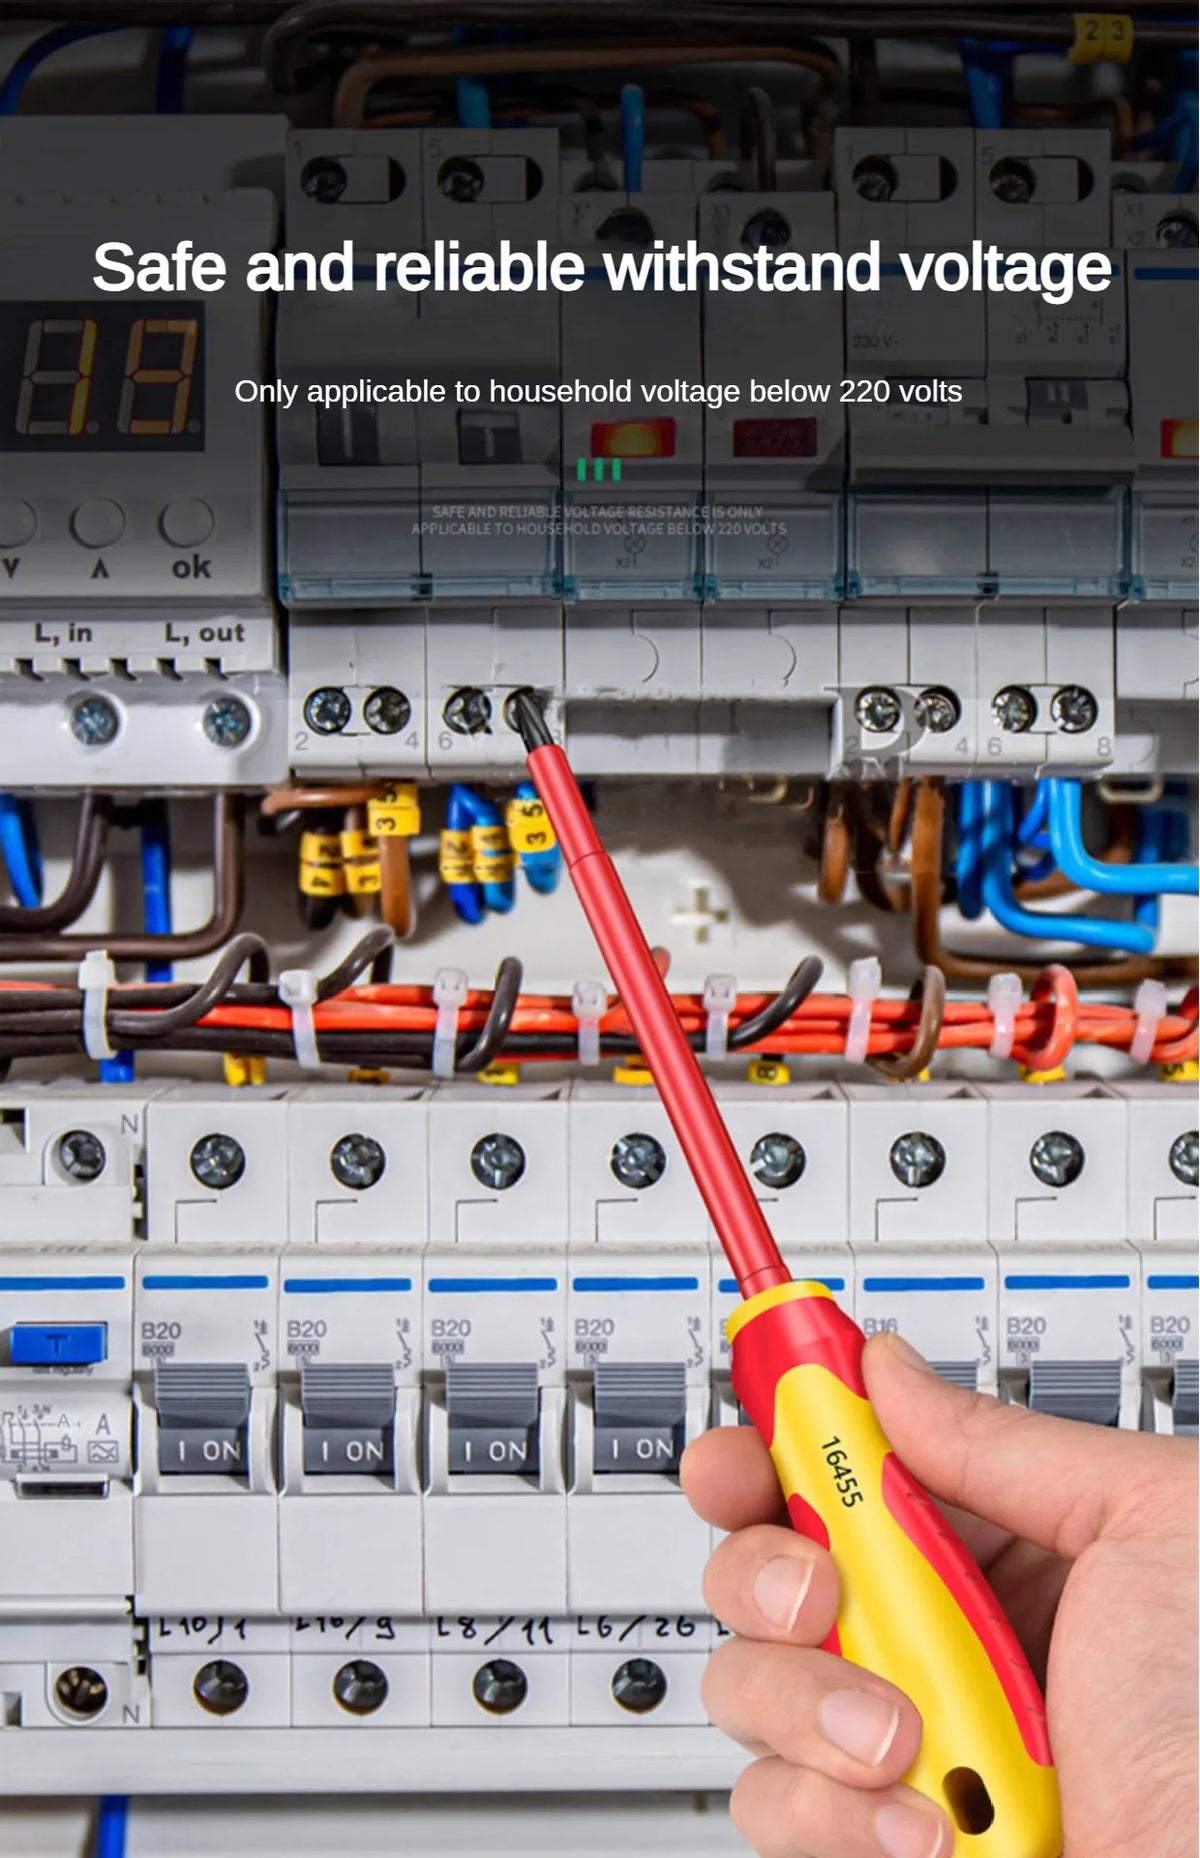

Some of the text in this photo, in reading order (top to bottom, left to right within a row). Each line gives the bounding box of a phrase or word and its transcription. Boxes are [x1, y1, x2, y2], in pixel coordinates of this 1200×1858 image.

[1086, 20, 1125, 41] 2 3
[173, 554, 211, 579] ok
[35, 622, 92, 647] L, in
[165, 622, 244, 647] L, out
[294, 731, 310, 751] 2
[404, 732, 419, 750] 4
[438, 732, 453, 751] 6
[954, 736, 969, 756] 4
[986, 736, 1002, 756] 6
[1097, 736, 1112, 757] 8
[525, 831, 547, 845] 3
[121, 1114, 138, 1133] N
[142, 1321, 182, 1340] B20
[287, 1320, 327, 1338] B20
[431, 1319, 472, 1337] B20
[575, 1318, 615, 1336] B20
[864, 1318, 898, 1335] B16
[1007, 1317, 1046, 1335] B20
[1150, 1316, 1190, 1334] B20
[44, 1333, 70, 1356] T
[96, 1412, 111, 1435] A
[203, 1440, 240, 1461] ON
[346, 1440, 384, 1461] ON
[489, 1440, 527, 1461] ON
[636, 1438, 674, 1459] ON
[822, 1435, 863, 1507] 16455
[122, 1704, 139, 1724] N
